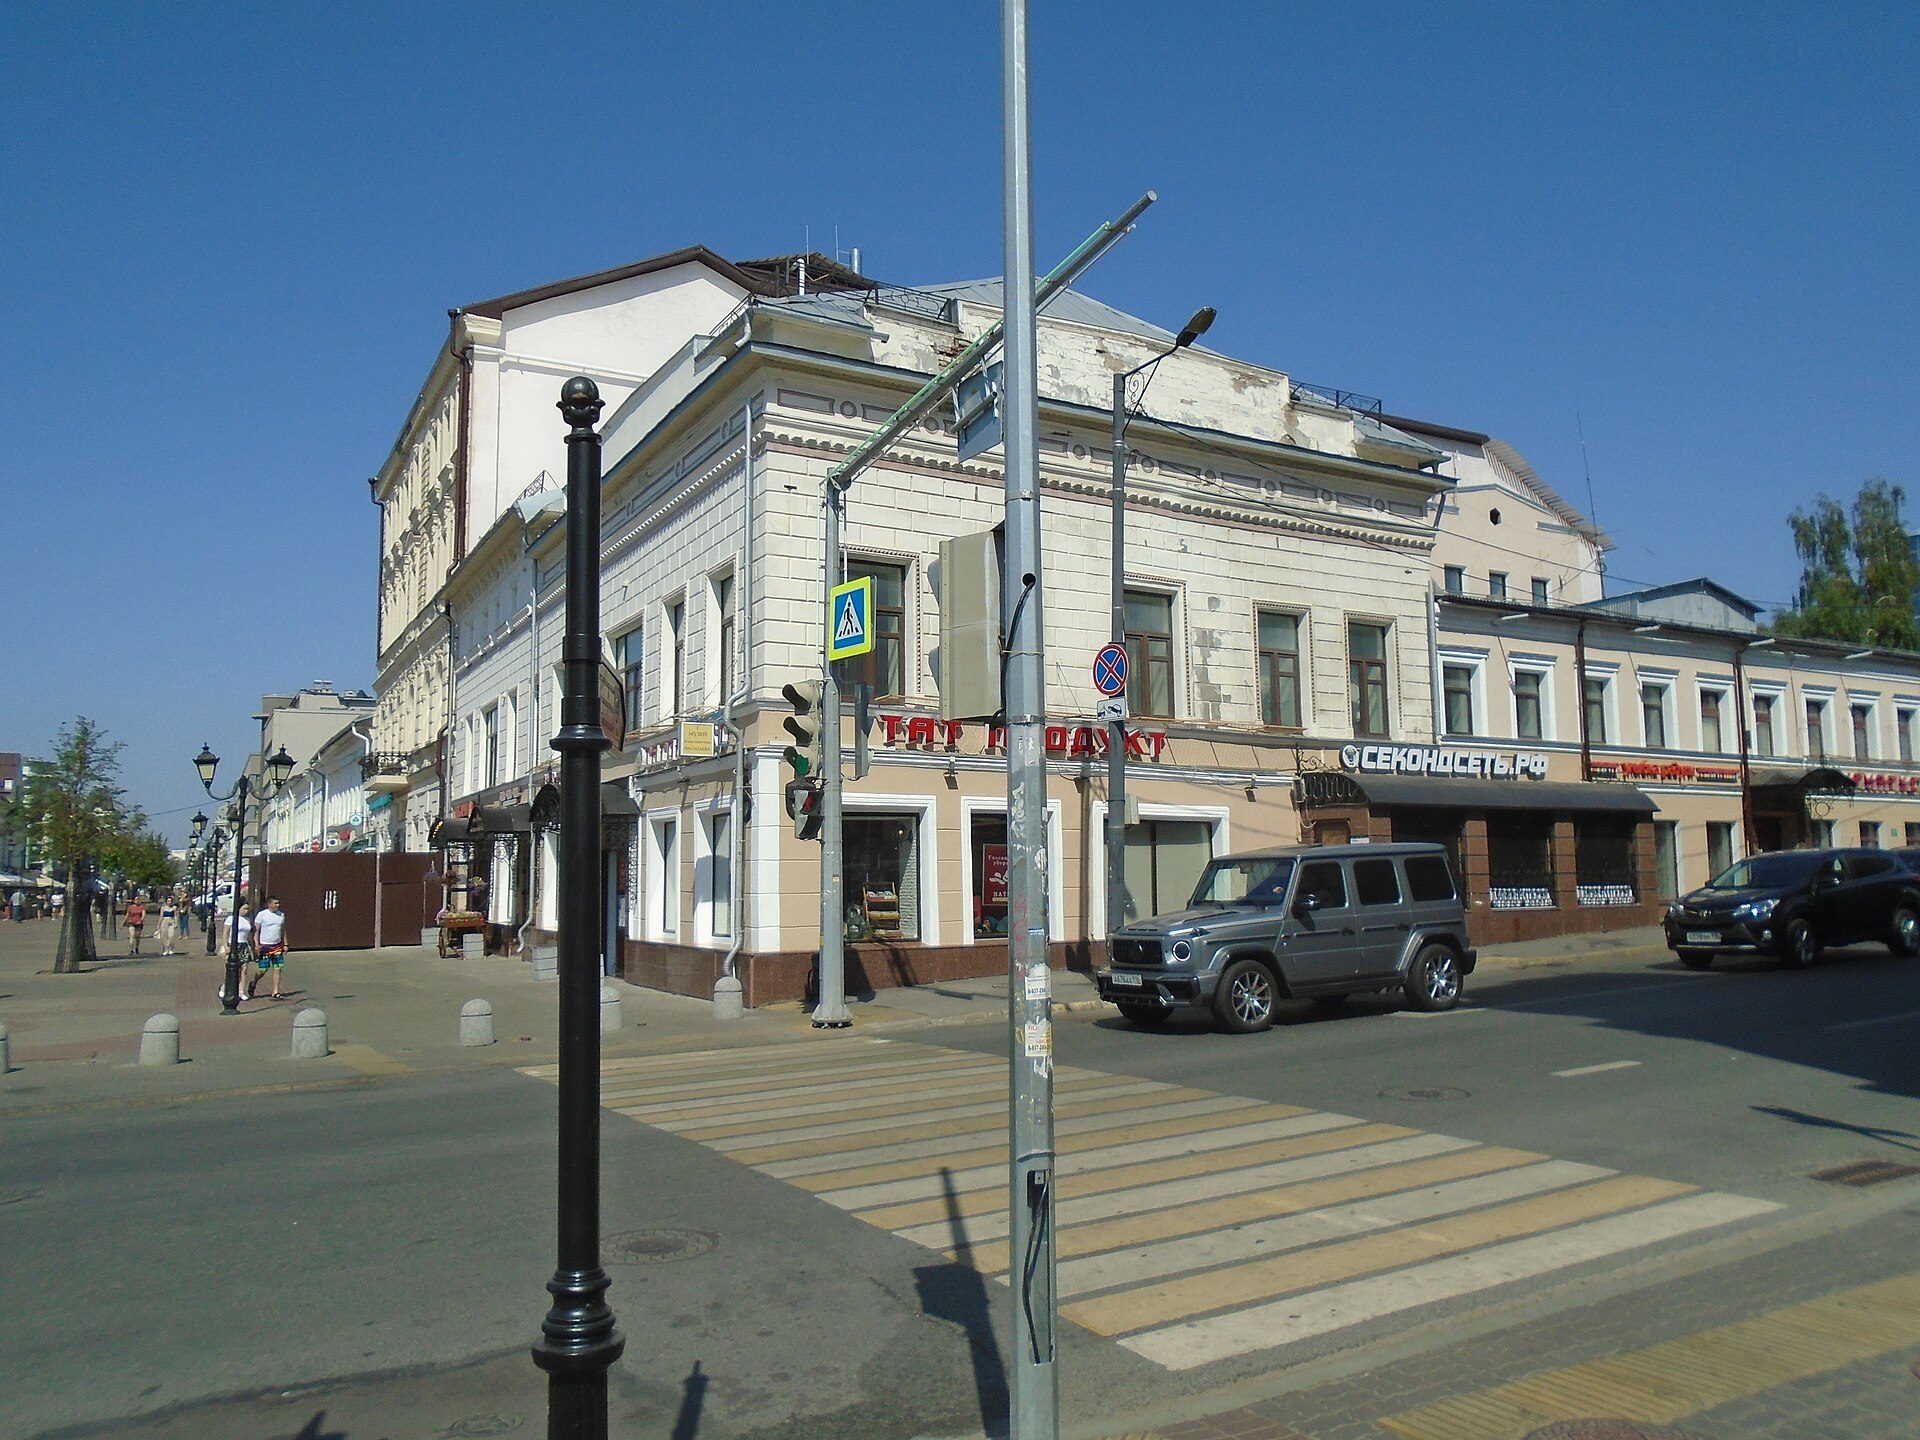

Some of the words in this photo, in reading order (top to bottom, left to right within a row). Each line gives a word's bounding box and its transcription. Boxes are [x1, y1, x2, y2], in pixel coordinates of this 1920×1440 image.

[880, 714, 963, 747] ТАТ
[984, 723, 1167, 758] ПОДУКТ
[1361, 745, 1550, 776] СЕКОНДСЕТЬ.РФ
